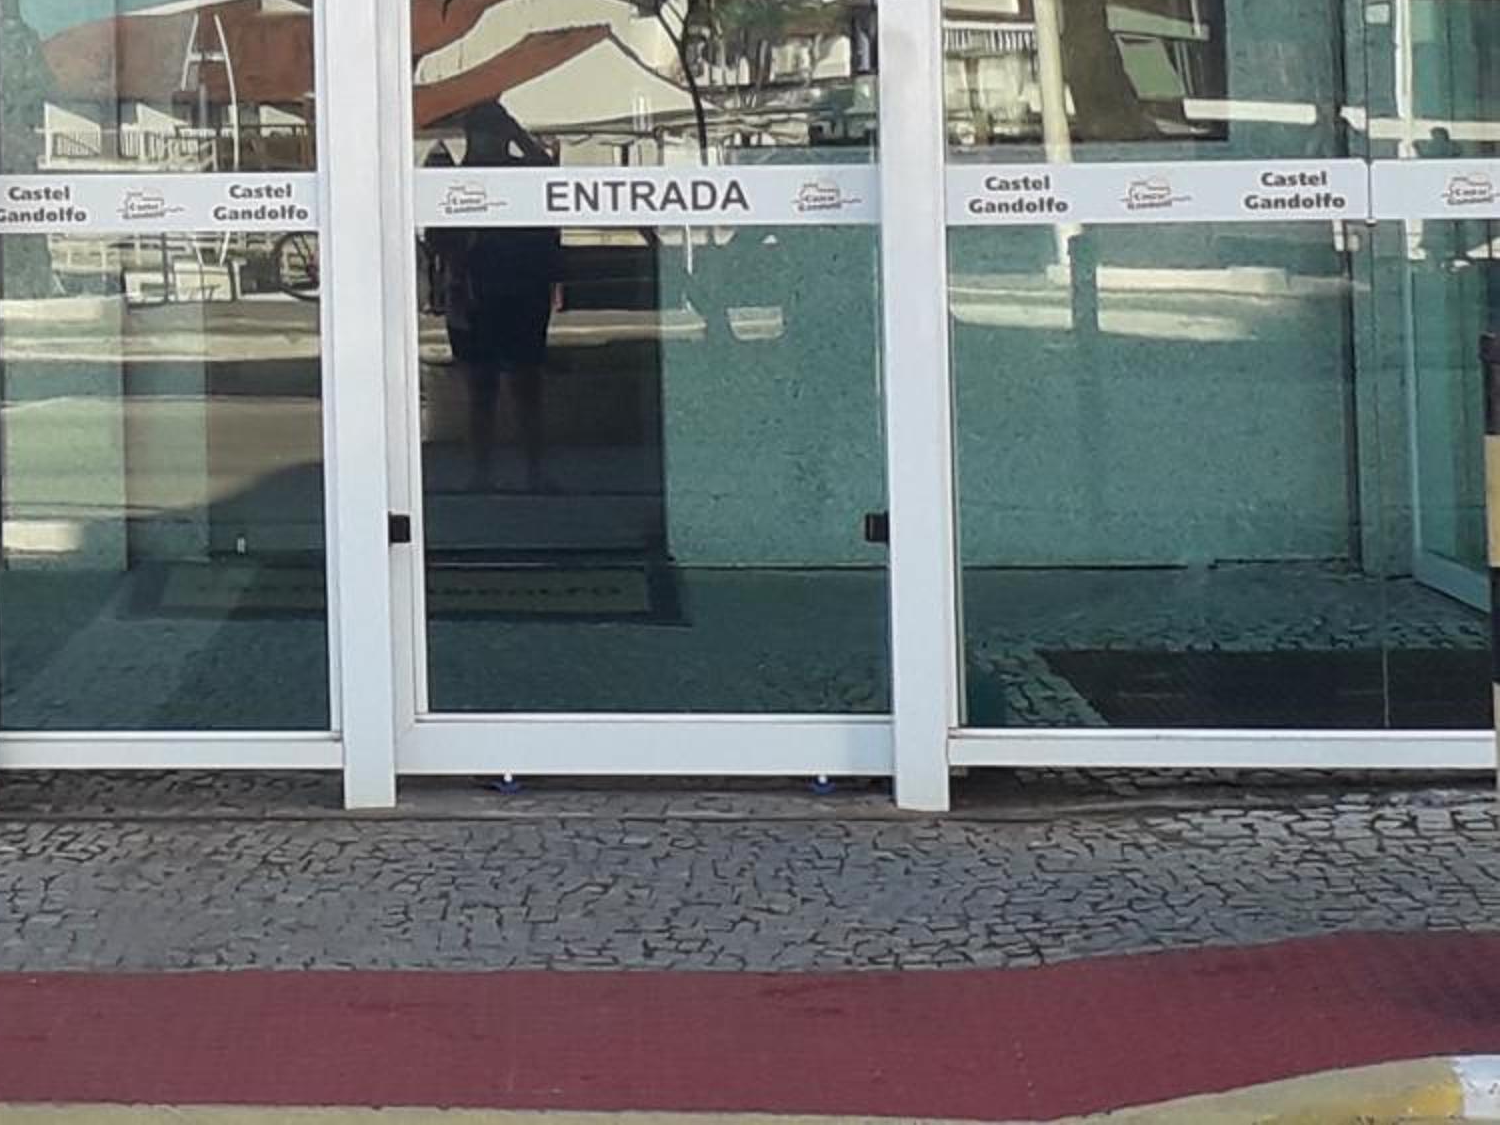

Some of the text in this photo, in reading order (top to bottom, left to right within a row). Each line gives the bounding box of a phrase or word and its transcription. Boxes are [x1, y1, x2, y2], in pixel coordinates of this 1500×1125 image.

[984, 174, 1051, 192] Castel
[1260, 170, 1328, 188] Castel
[7, 185, 71, 202] Castel
[228, 182, 293, 200] Castel
[545, 178, 750, 213] ENTRADA
[968, 196, 1070, 215] Gandolfo
[1244, 192, 1347, 211] Gandolfo
[213, 203, 309, 221] Gandolfo
